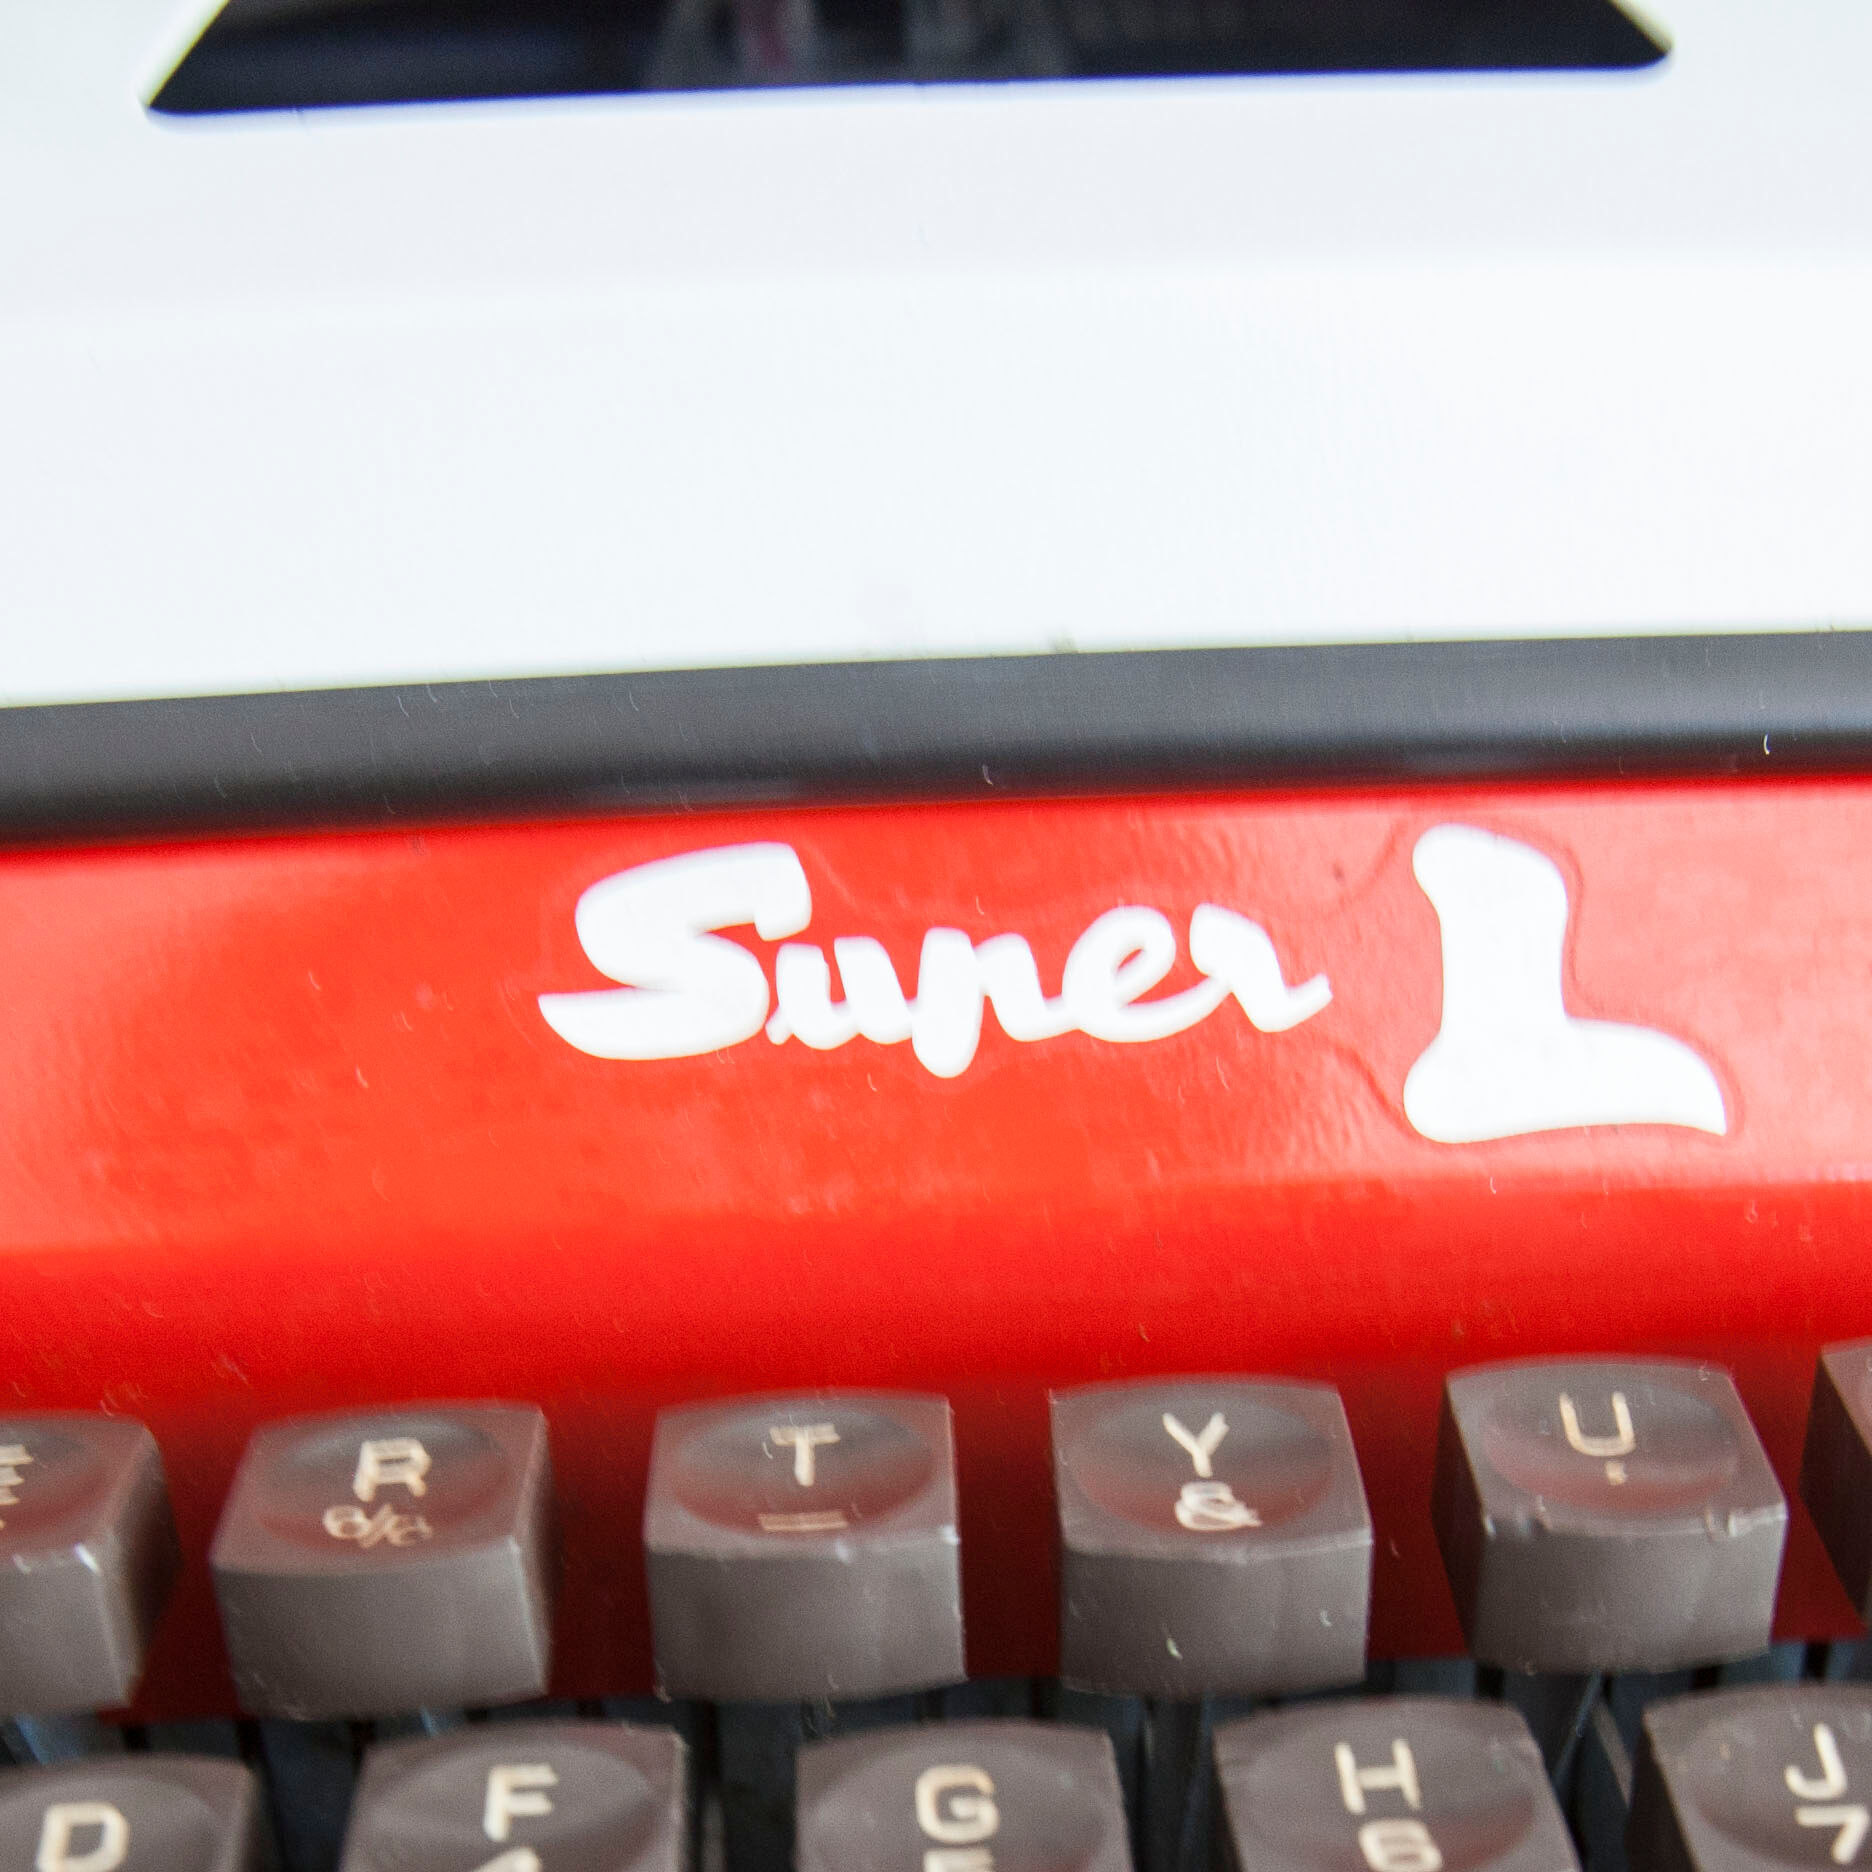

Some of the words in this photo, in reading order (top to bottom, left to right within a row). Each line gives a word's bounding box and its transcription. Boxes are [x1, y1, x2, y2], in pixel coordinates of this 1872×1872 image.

[537, 841, 1333, 1079] Super
[1404, 822, 1728, 1143] L
[769, 1423, 841, 1487] T
[1162, 1411, 1229, 1478] Y
[1559, 1391, 1636, 1457] U
[352, 1435, 432, 1502] R
[1334, 1737, 1424, 1815] H
[1785, 1722, 1849, 1800] J
[483, 1763, 559, 1843] F
[914, 1764, 1001, 1844] G
[1794, 1804, 1871, 1866] 7
